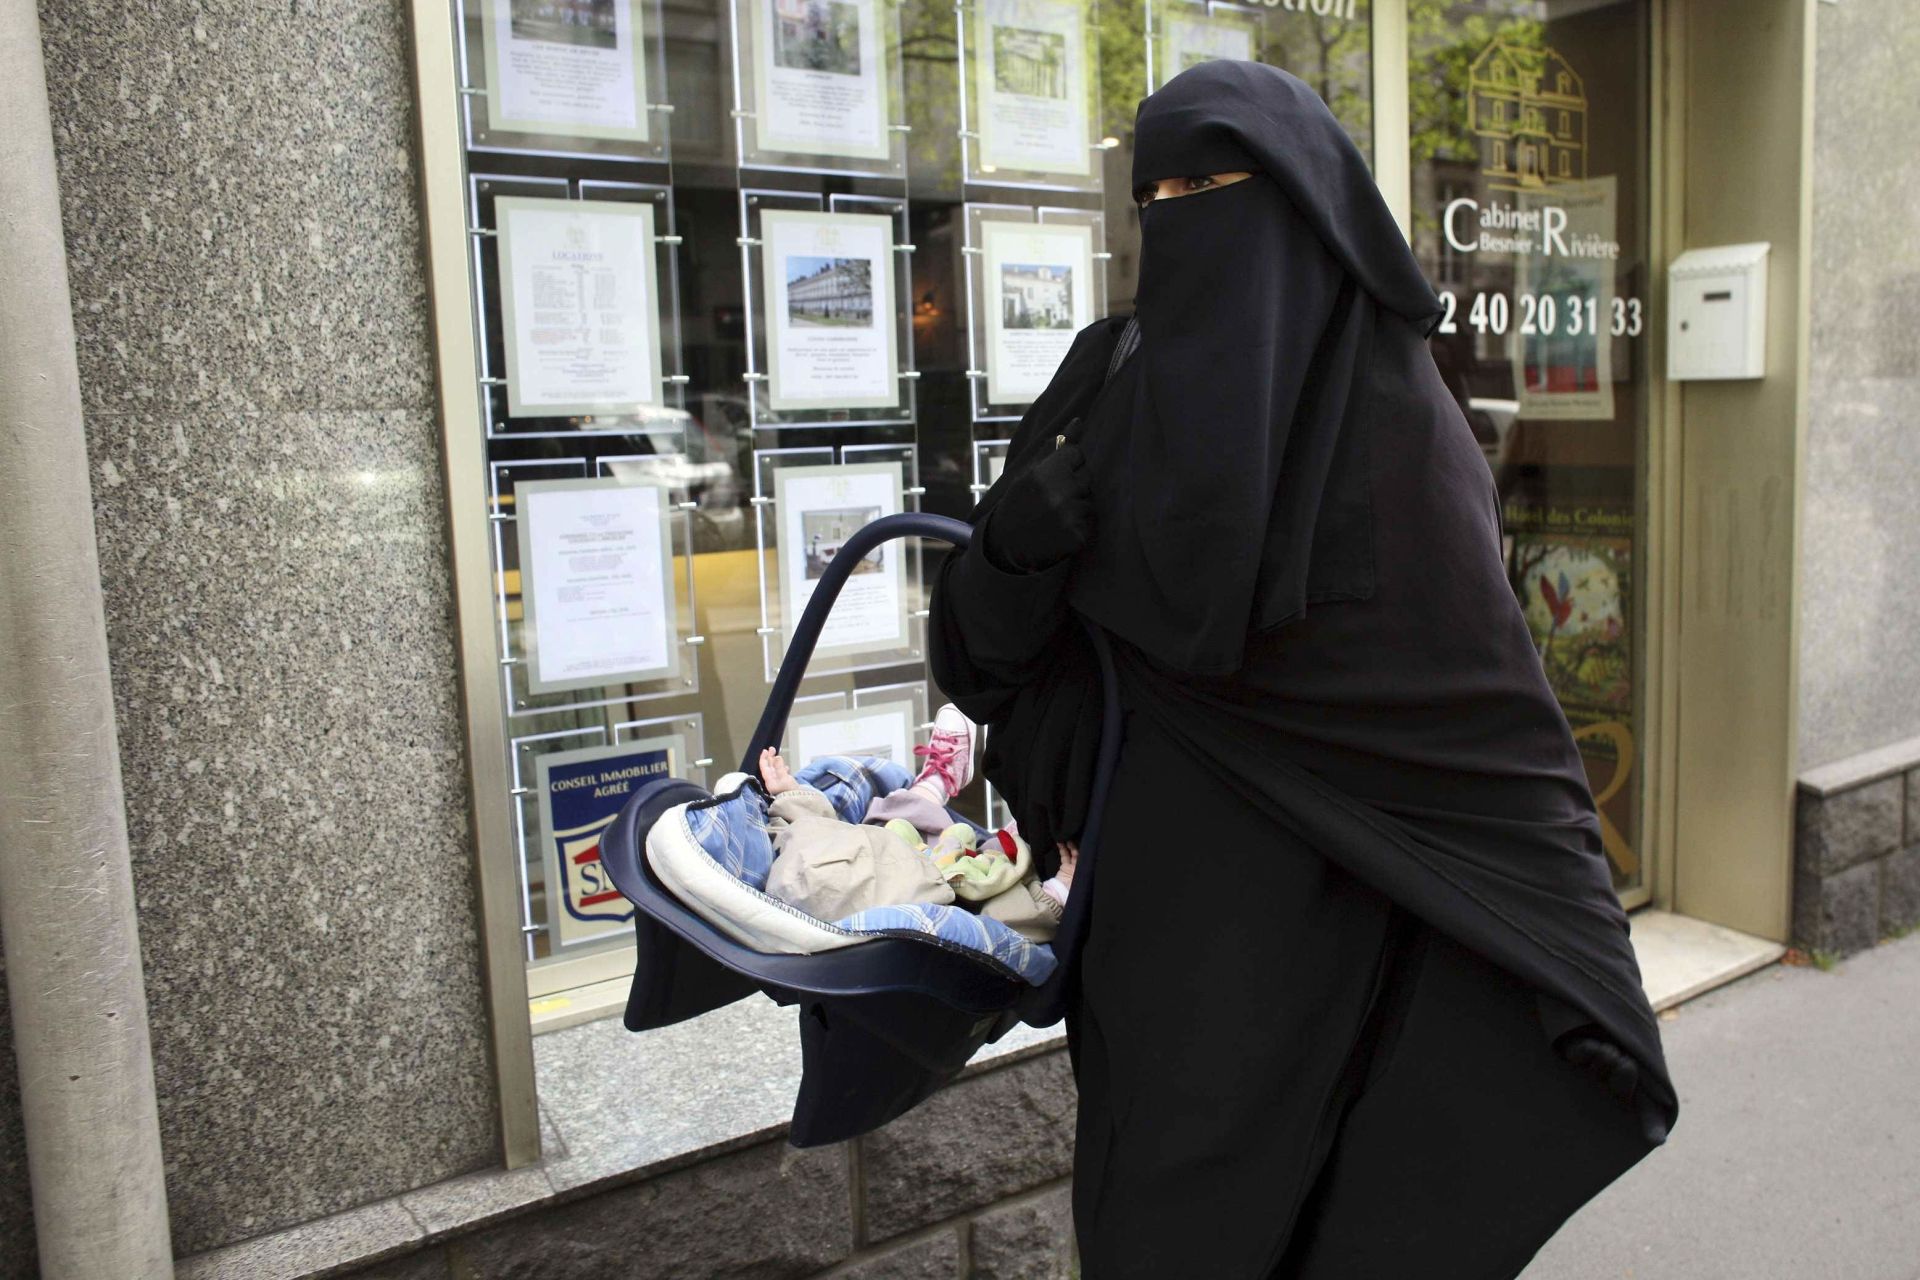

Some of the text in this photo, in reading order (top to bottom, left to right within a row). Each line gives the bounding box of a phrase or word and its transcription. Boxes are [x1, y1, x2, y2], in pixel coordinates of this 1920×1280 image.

[1543, 206, 1620, 260] Rivière
[1469, 292, 1509, 335] 40
[1520, 294, 1556, 335] 20
[1566, 295, 1597, 335] 31
[1611, 297, 1642, 337] 33
[551, 761, 668, 792] CONSEIL IMMOBILIER
